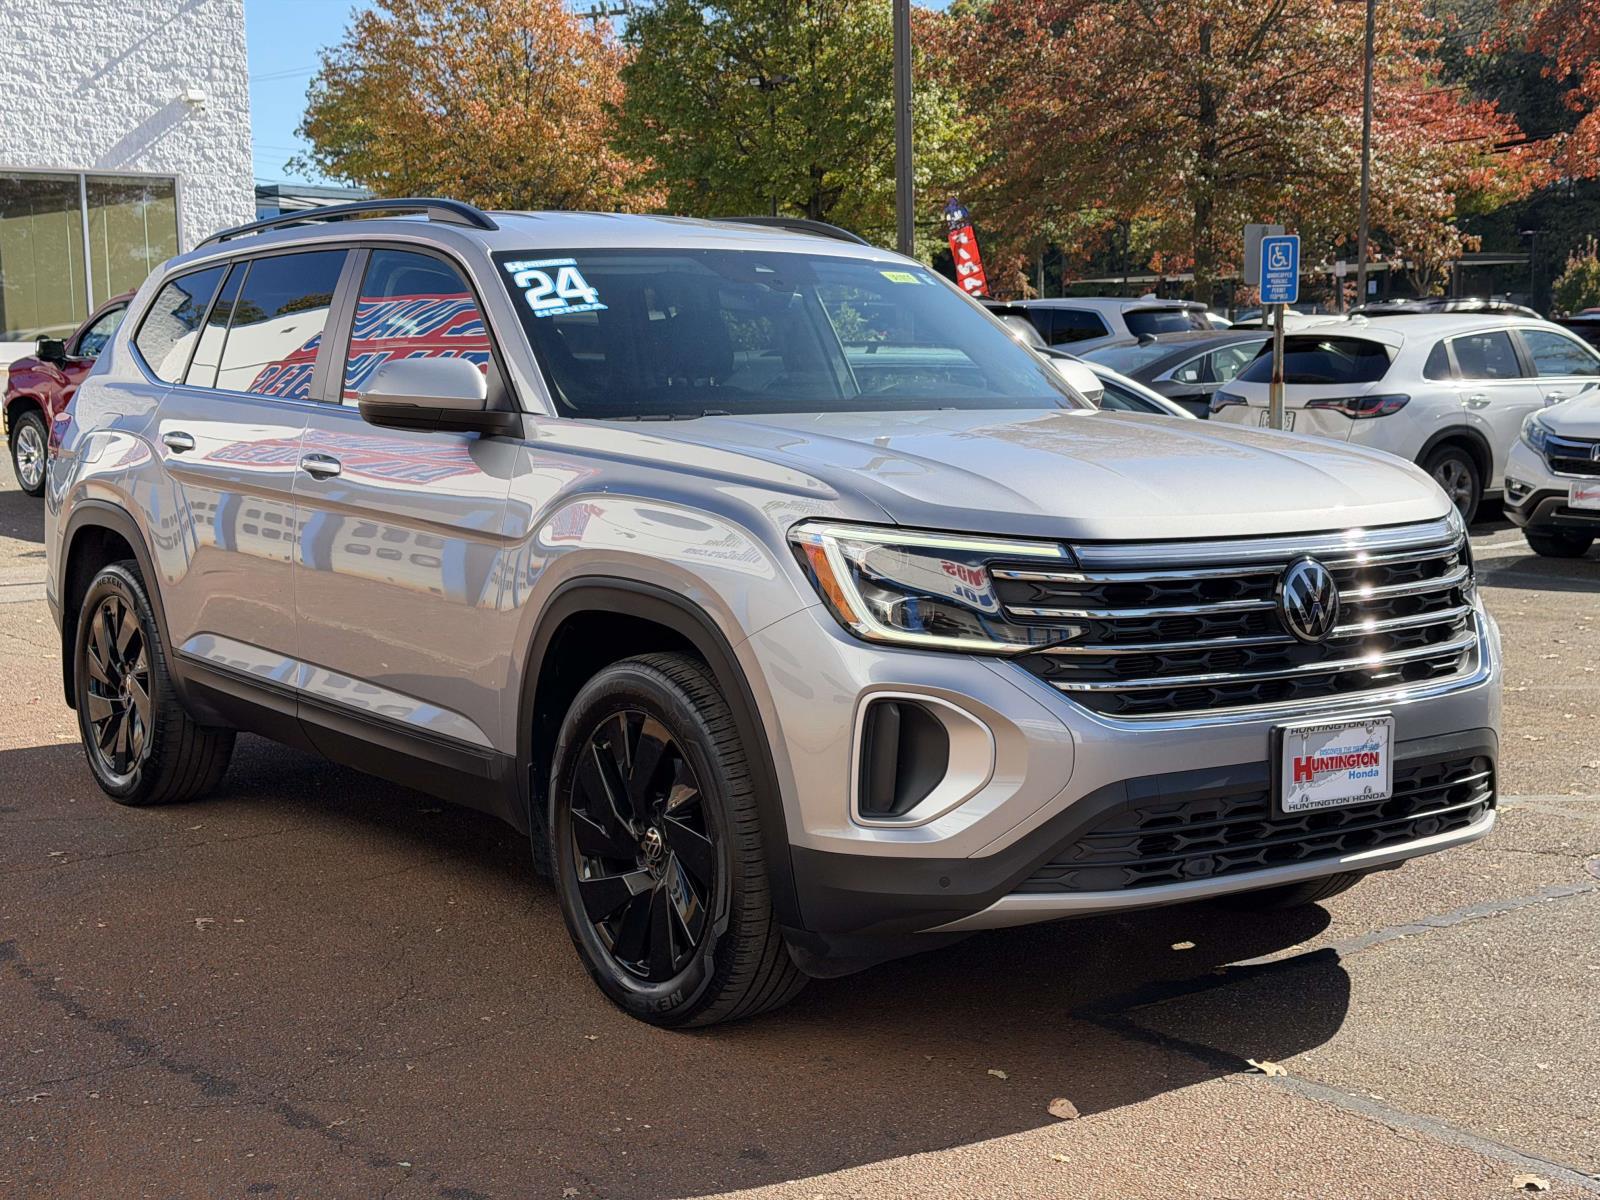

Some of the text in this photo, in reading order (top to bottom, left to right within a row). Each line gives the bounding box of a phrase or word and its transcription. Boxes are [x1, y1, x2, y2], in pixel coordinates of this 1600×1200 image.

[514, 266, 599, 311] 24
[534, 303, 609, 318] HONDA
[96, 576, 122, 589] NEXEN
[1290, 718, 1388, 735] HUNTINGTON, NY
[1293, 752, 1380, 784] HUNTINGTON
[1348, 769, 1379, 780] Honda
[1288, 792, 1386, 811] HUNTINGTON HONDA
